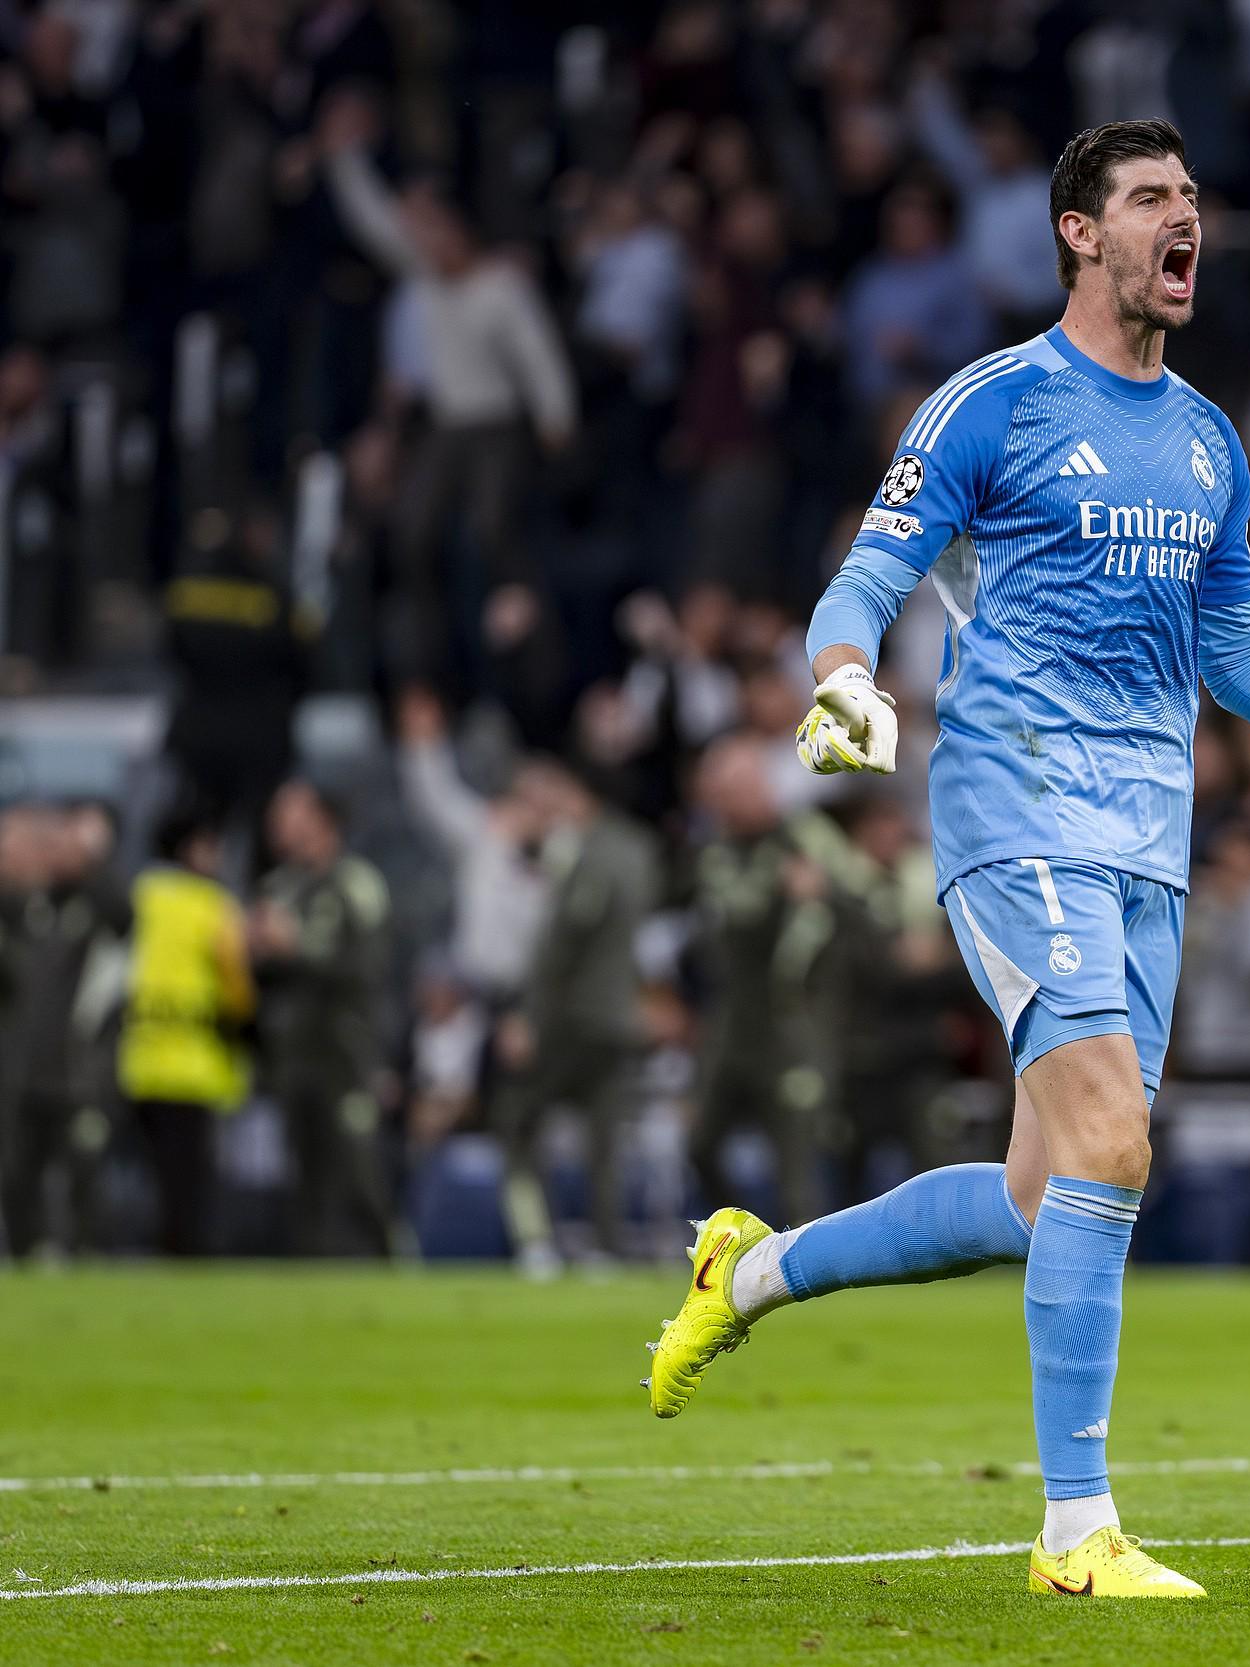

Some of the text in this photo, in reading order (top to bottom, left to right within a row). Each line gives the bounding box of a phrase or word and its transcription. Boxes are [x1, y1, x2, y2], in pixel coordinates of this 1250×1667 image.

[1078, 498, 1216, 551] Emirates
[1105, 544, 1143, 576] FLY
[1020, 858, 1065, 925] 1
